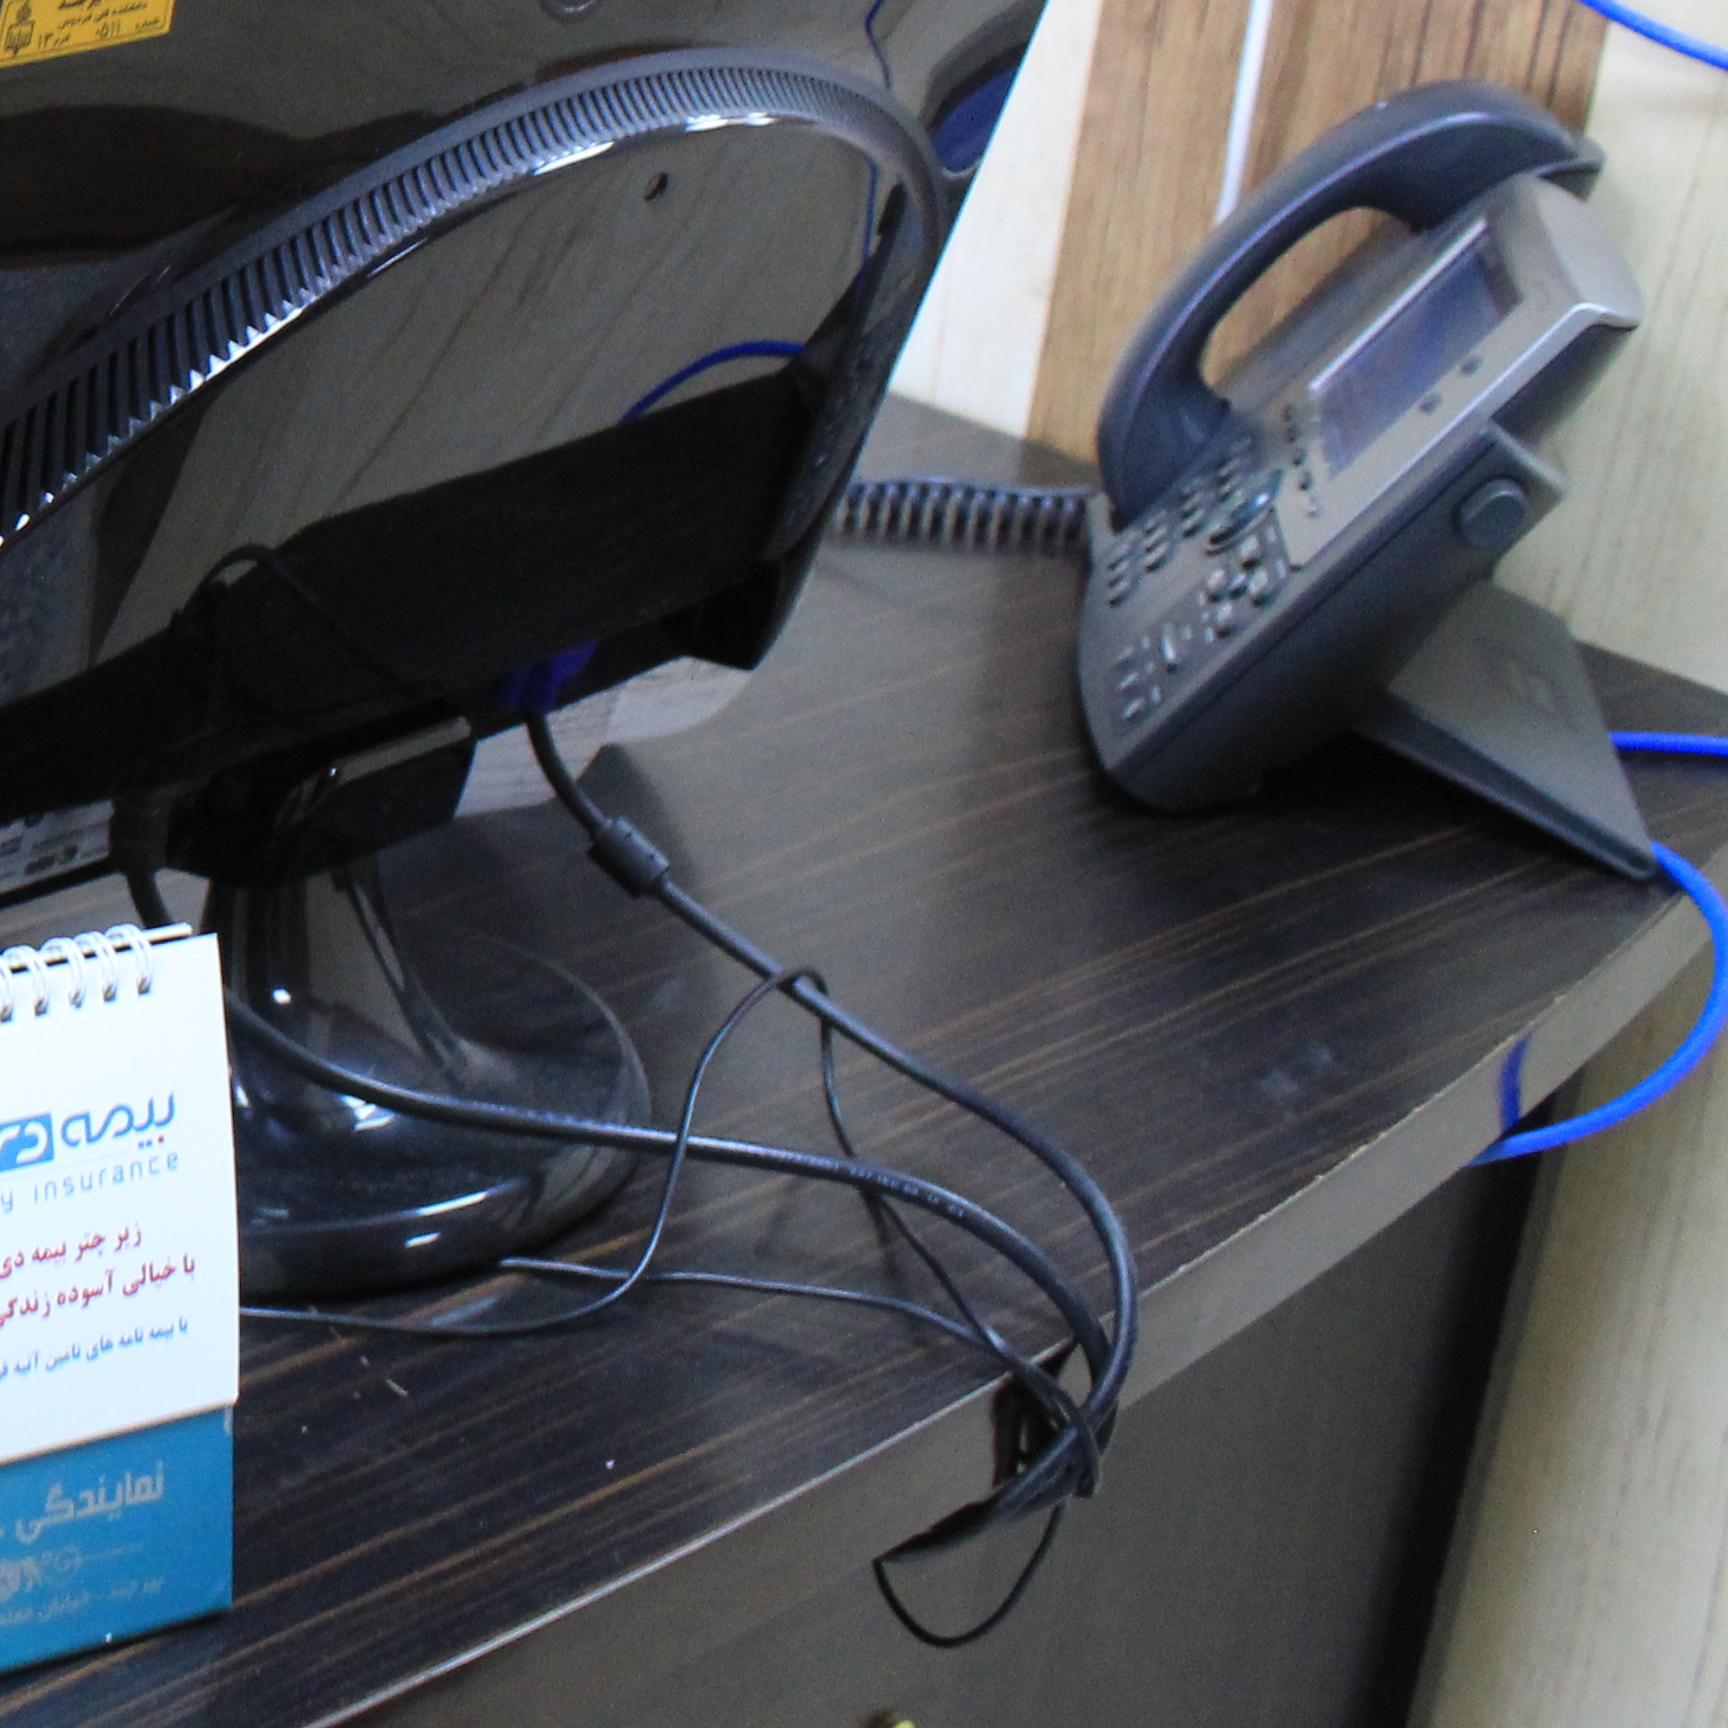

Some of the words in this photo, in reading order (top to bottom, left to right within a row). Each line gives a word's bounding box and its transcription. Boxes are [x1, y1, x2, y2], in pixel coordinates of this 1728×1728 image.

[60, 1090, 176, 1150] بیمه
[33, 1151, 179, 1204] insurance
[31, 1241, 67, 1267] بیمه
[74, 1232, 106, 1261] چتر
[114, 1221, 142, 1252] زیر
[122, 1256, 176, 1296] خیالی
[182, 1253, 196, 1280] با
[57, 1268, 115, 1308] آسوده
[16, 1460, 166, 1544] نمایندگی
